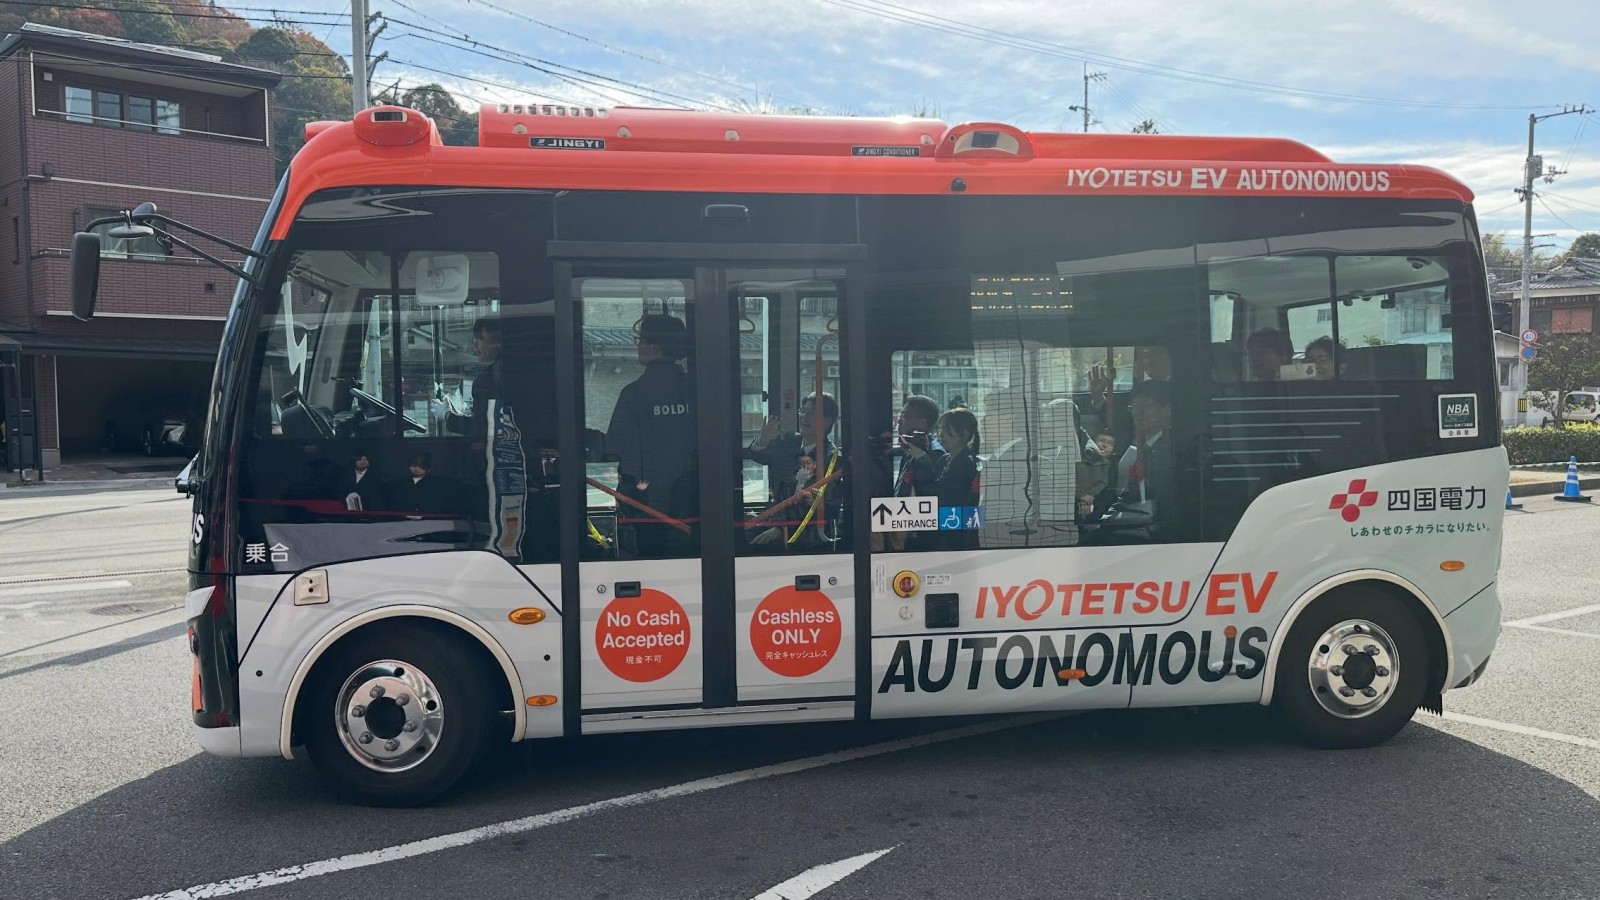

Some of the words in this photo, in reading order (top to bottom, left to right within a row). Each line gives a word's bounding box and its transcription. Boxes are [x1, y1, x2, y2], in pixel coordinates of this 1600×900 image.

[548, 139, 599, 148] JINGYI
[1067, 167, 1182, 189] IYOTETSU
[1190, 168, 1227, 189] EV
[1236, 169, 1390, 191] AUTONOMOUS
[653, 404, 689, 416] BOLD
[1446, 404, 1470, 414] NBA
[1387, 486, 1486, 511] 四国電力
[897, 500, 932, 515] 入口
[891, 519, 937, 529] ENTRANCE
[1350, 522, 1491, 538] しあわせのチカラになりたい。
[246, 542, 290, 563] 乗合
[975, 579, 1191, 621] IYOTETSU
[1205, 571, 1279, 616] EV
[607, 612, 631, 627] No
[636, 610, 681, 627] Cash
[758, 608, 835, 626] Cashless
[602, 630, 685, 649] Accepted
[771, 628, 821, 645] ONLY
[625, 655, 662, 664] 現金不可
[765, 651, 828, 660] 完全キャッシュレス
[878, 625, 1269, 694] AUTONOMOUS
